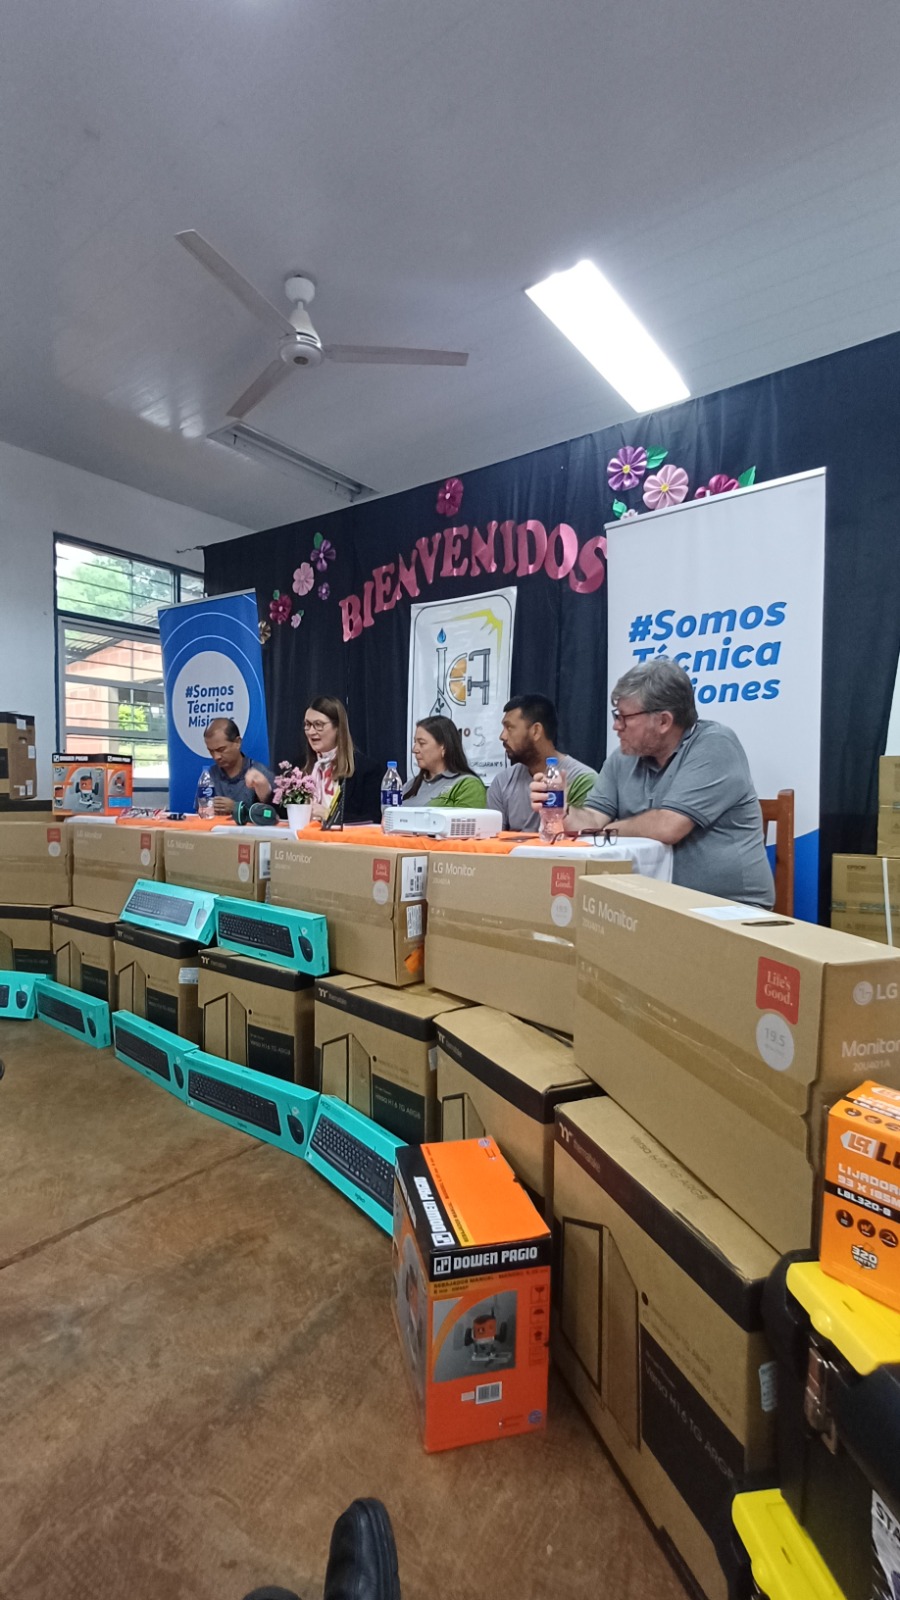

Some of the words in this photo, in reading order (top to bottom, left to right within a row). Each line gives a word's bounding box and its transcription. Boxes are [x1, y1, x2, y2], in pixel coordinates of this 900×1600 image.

[339, 520, 607, 642] BIENVENIDOS
[629, 602, 787, 642] #Somos
[185, 684, 234, 698] #Somos
[187, 698, 234, 714] Técnica
[275, 850, 284, 860] LG
[286, 851, 313, 864] Monitor
[433, 862, 443, 874] LG
[445, 862, 476, 877] Monitor
[582, 895, 596, 914] LG
[598, 901, 638, 932] Monitor
[767, 970, 791, 991] Life's
[876, 982, 898, 999] LG
[764, 984, 793, 1006] Good.
[453, 1252, 498, 1270] DOWEN
[501, 1247, 538, 1263] PAGIO
[852, 1245, 877, 1264] 320
